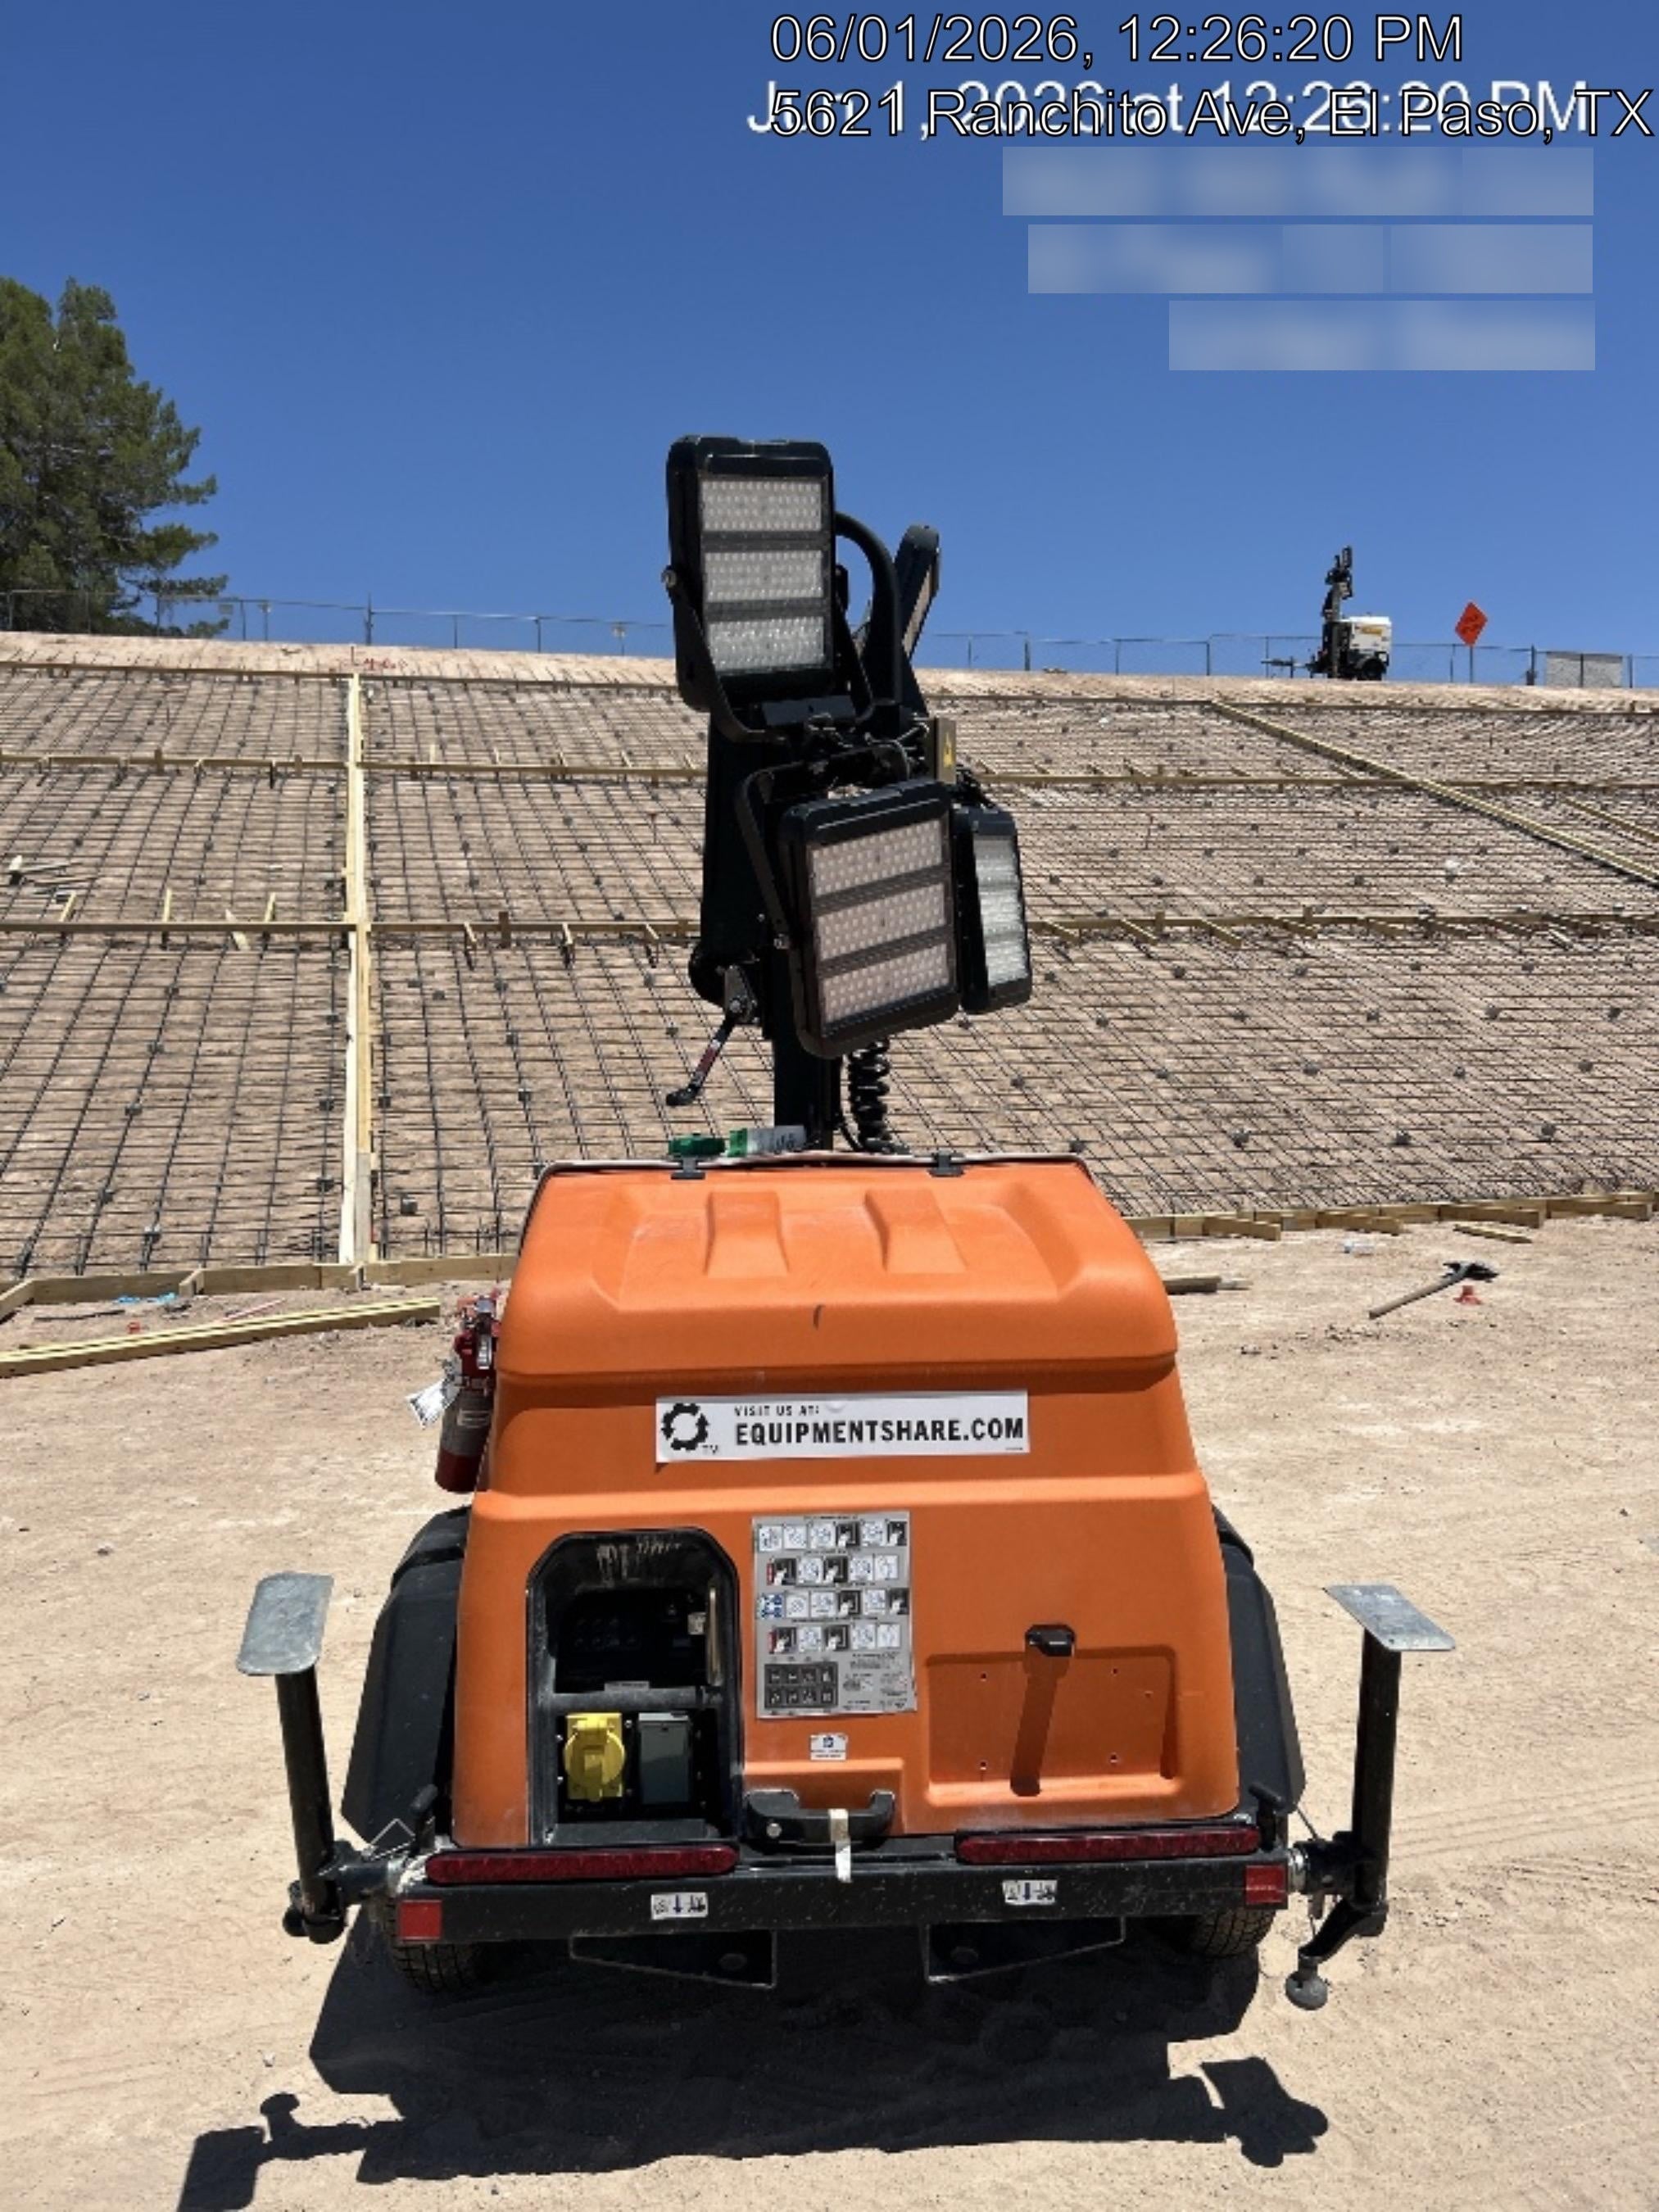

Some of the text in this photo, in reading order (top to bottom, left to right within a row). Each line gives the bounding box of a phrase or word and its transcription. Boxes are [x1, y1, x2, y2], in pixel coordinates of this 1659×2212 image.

[734, 1404, 770, 1416] VISIT
[776, 1404, 793, 1416] US
[736, 1416, 1024, 1447] EQUIPMENTSHARE.COM
